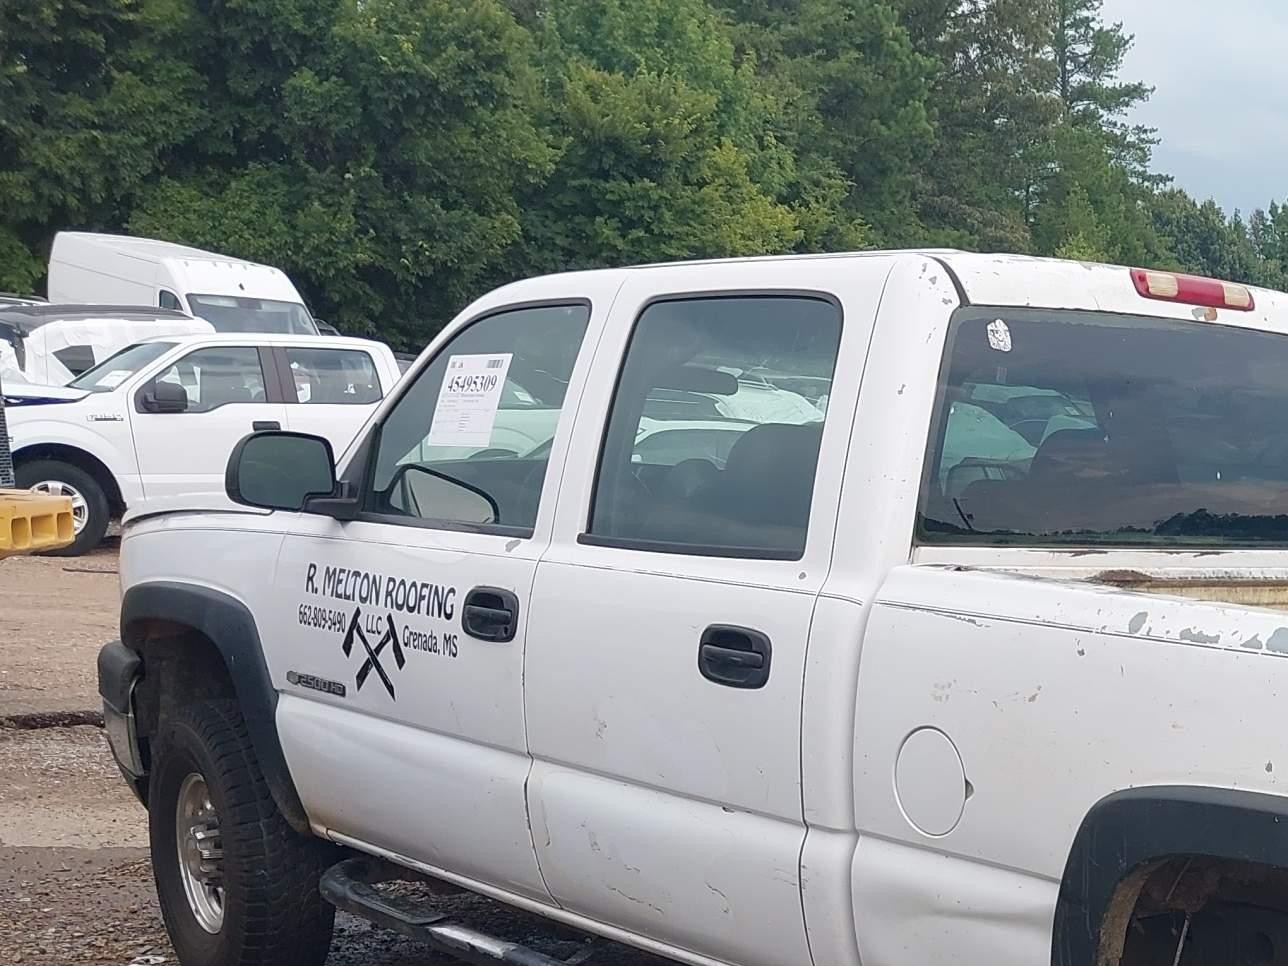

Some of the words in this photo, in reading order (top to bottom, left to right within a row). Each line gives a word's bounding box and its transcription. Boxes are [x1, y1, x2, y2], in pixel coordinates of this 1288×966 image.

[447, 375, 498, 392] 45495309
[305, 563, 319, 595] R.
[322, 566, 382, 606] MELTON
[384, 576, 457, 621] ROOFING
[298, 603, 346, 634] 662-809-5490
[366, 614, 383, 635] LLC
[442, 632, 458, 658] MS
